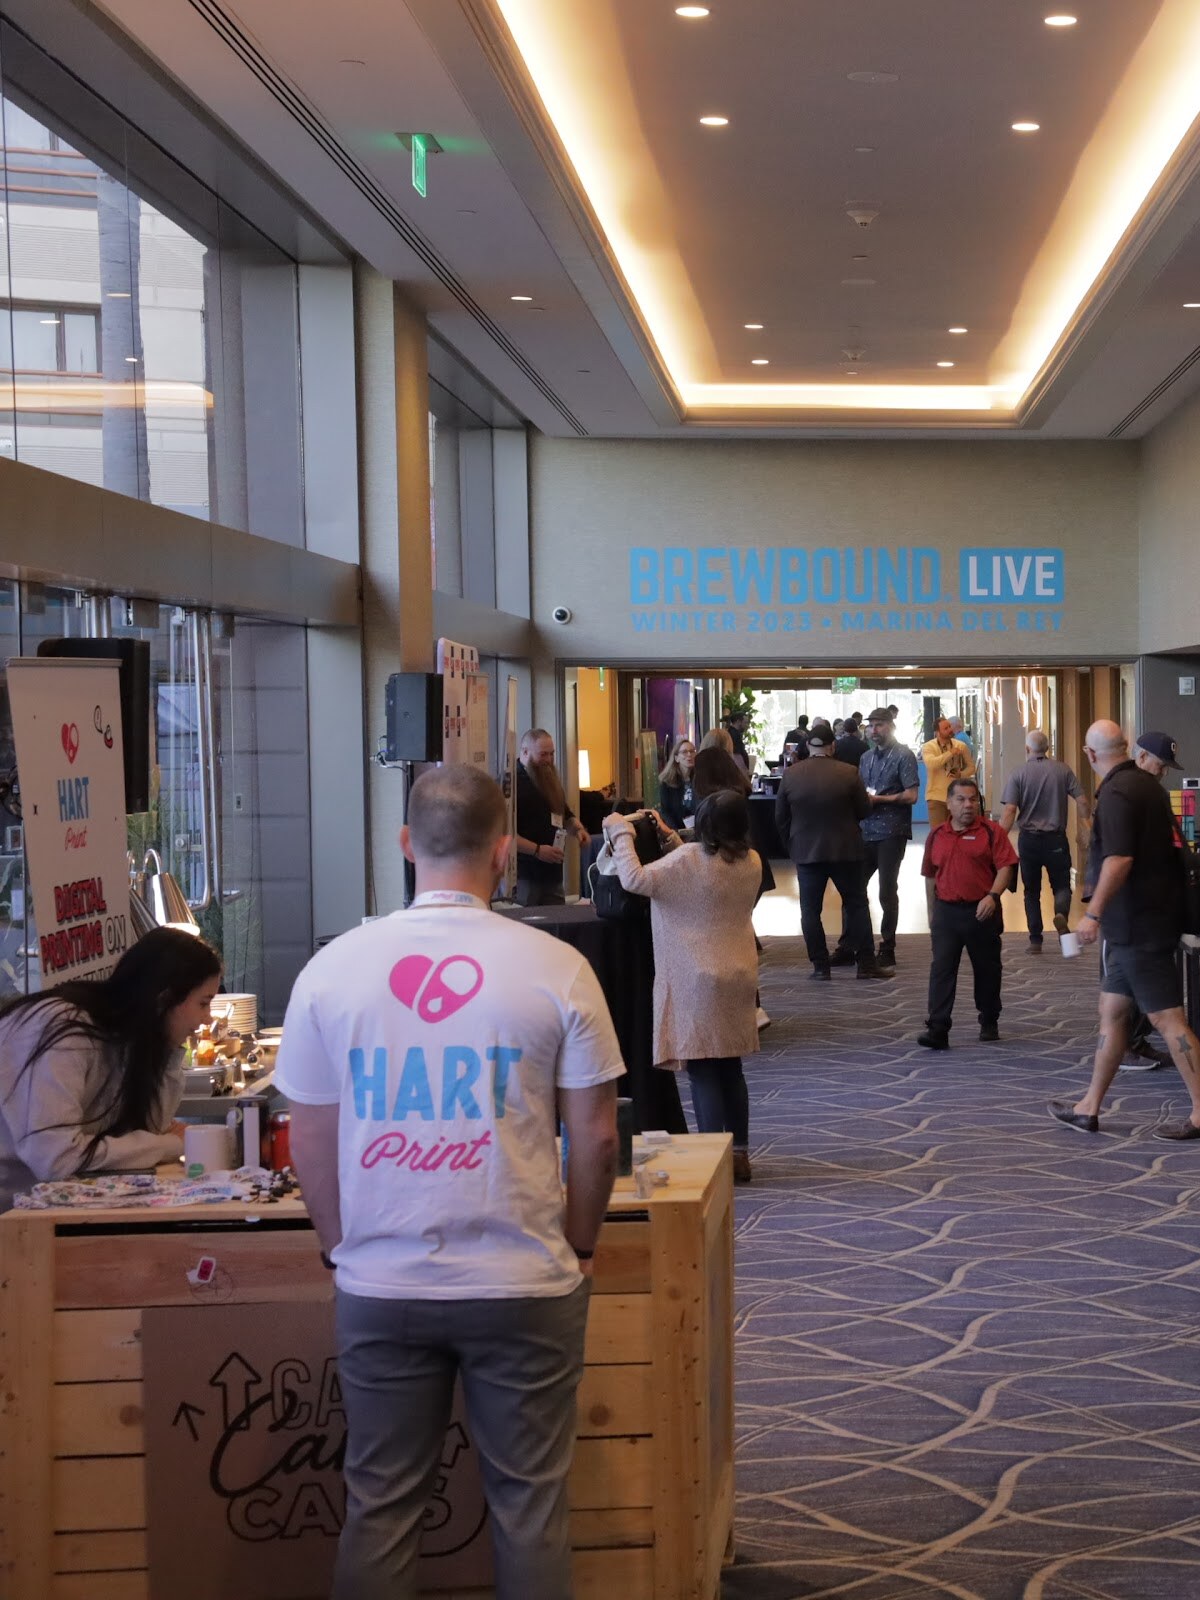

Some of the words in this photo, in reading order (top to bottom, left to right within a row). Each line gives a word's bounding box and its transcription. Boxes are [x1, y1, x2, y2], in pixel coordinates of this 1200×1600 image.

[968, 555, 1056, 597] LIVE
[631, 611, 737, 633] WINTER
[747, 611, 813, 633] 2023
[841, 610, 954, 632] MARINA
[961, 611, 1009, 632] DEL
[1015, 611, 1065, 632] REY
[57, 776, 90, 822] HART
[64, 826, 88, 851] Print
[54, 877, 107, 925] DIGITAL
[40, 920, 104, 976] PRINTING
[105, 915, 127, 956] ON
[348, 1046, 523, 1121] HART
[361, 1130, 491, 1172] Print
